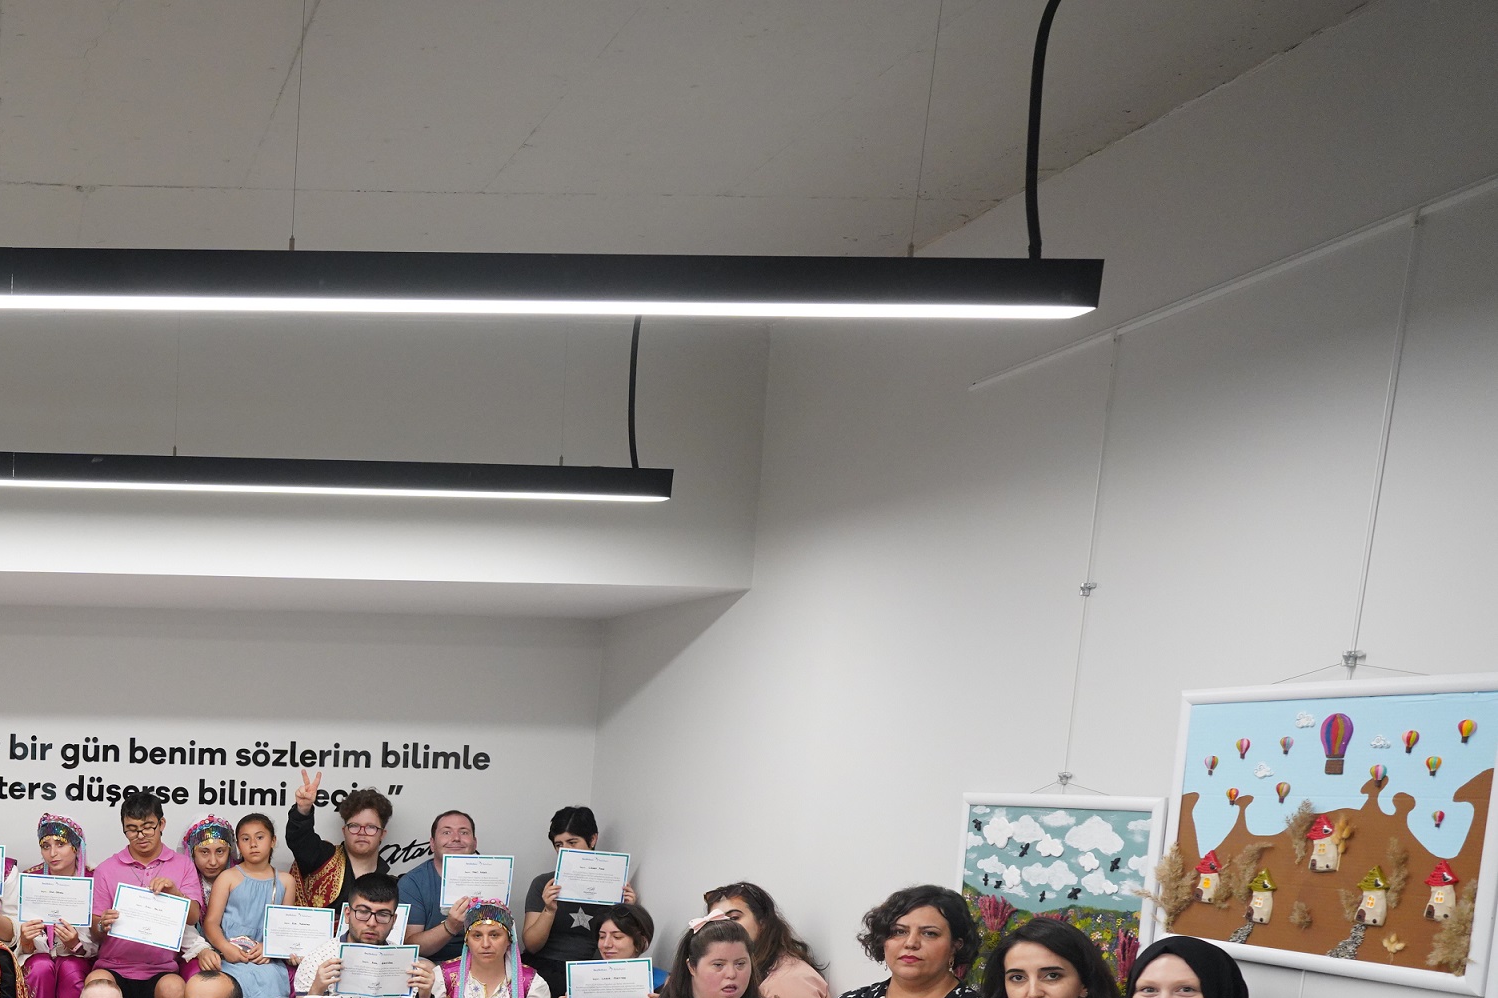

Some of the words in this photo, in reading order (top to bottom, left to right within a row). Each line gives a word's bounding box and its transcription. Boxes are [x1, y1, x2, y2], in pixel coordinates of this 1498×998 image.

[10, 734, 52, 760] bir
[61, 737, 119, 769] gün
[130, 738, 226, 766] benim
[236, 741, 371, 768] sözlerim
[381, 742, 490, 770] bilimle
[199, 779, 286, 806] bilimi
